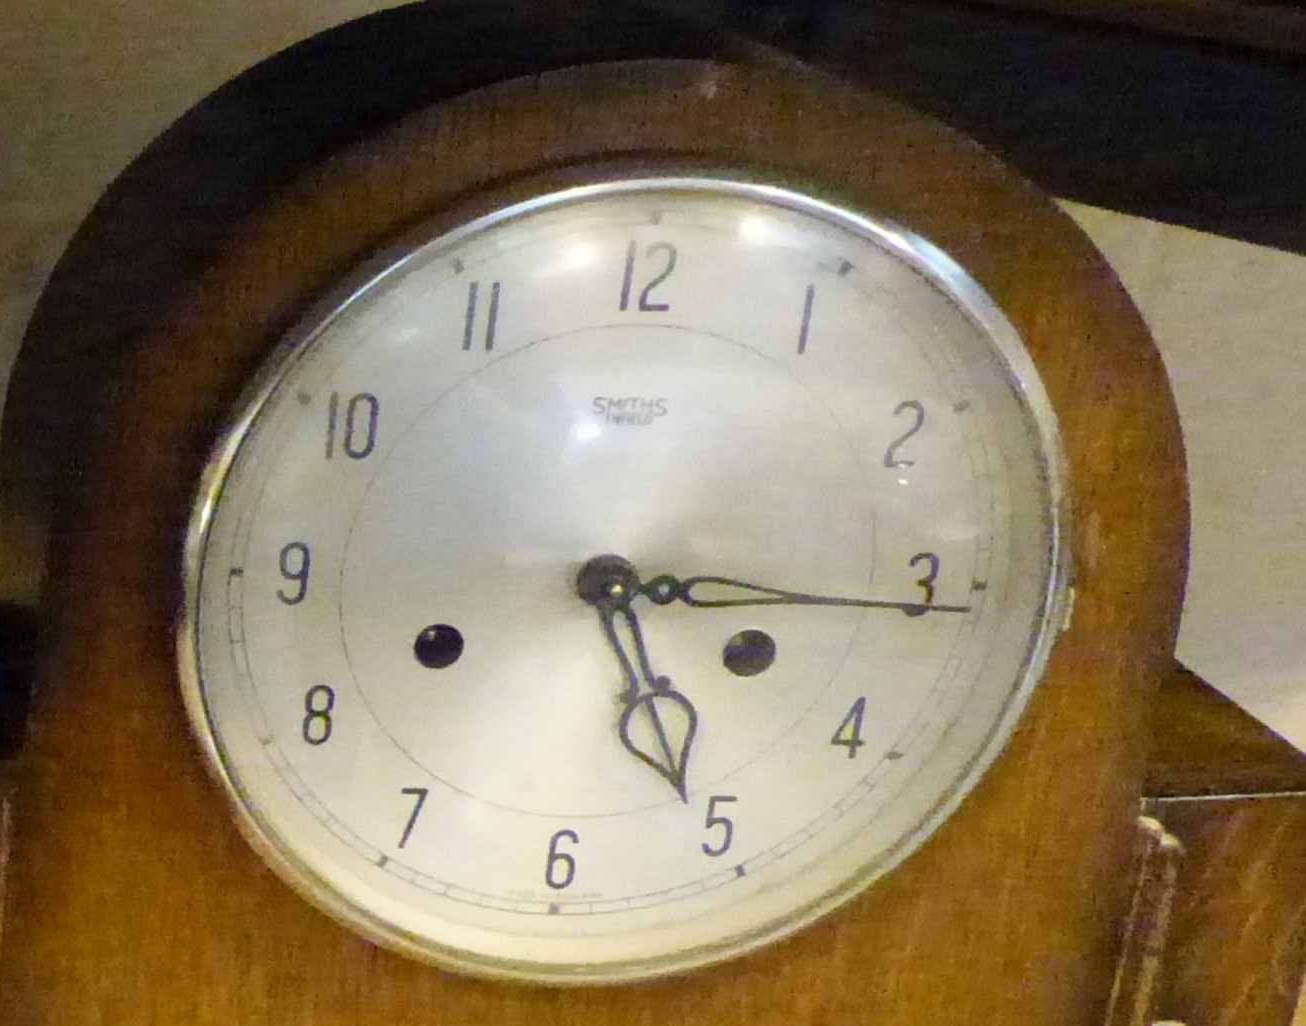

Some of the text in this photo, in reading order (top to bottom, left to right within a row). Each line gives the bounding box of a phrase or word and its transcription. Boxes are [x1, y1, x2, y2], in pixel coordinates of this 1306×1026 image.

[617, 240, 678, 313] 12
[460, 280, 501, 351] 11
[797, 284, 816, 354] 1
[323, 391, 380, 461] 10
[882, 400, 926, 469] 2
[275, 541, 311, 606] 9
[906, 551, 941, 617] 3
[300, 685, 336, 745] 8
[830, 696, 867, 759] 4
[397, 787, 429, 849] 7
[701, 795, 739, 858] 5
[544, 829, 580, 890] 6
